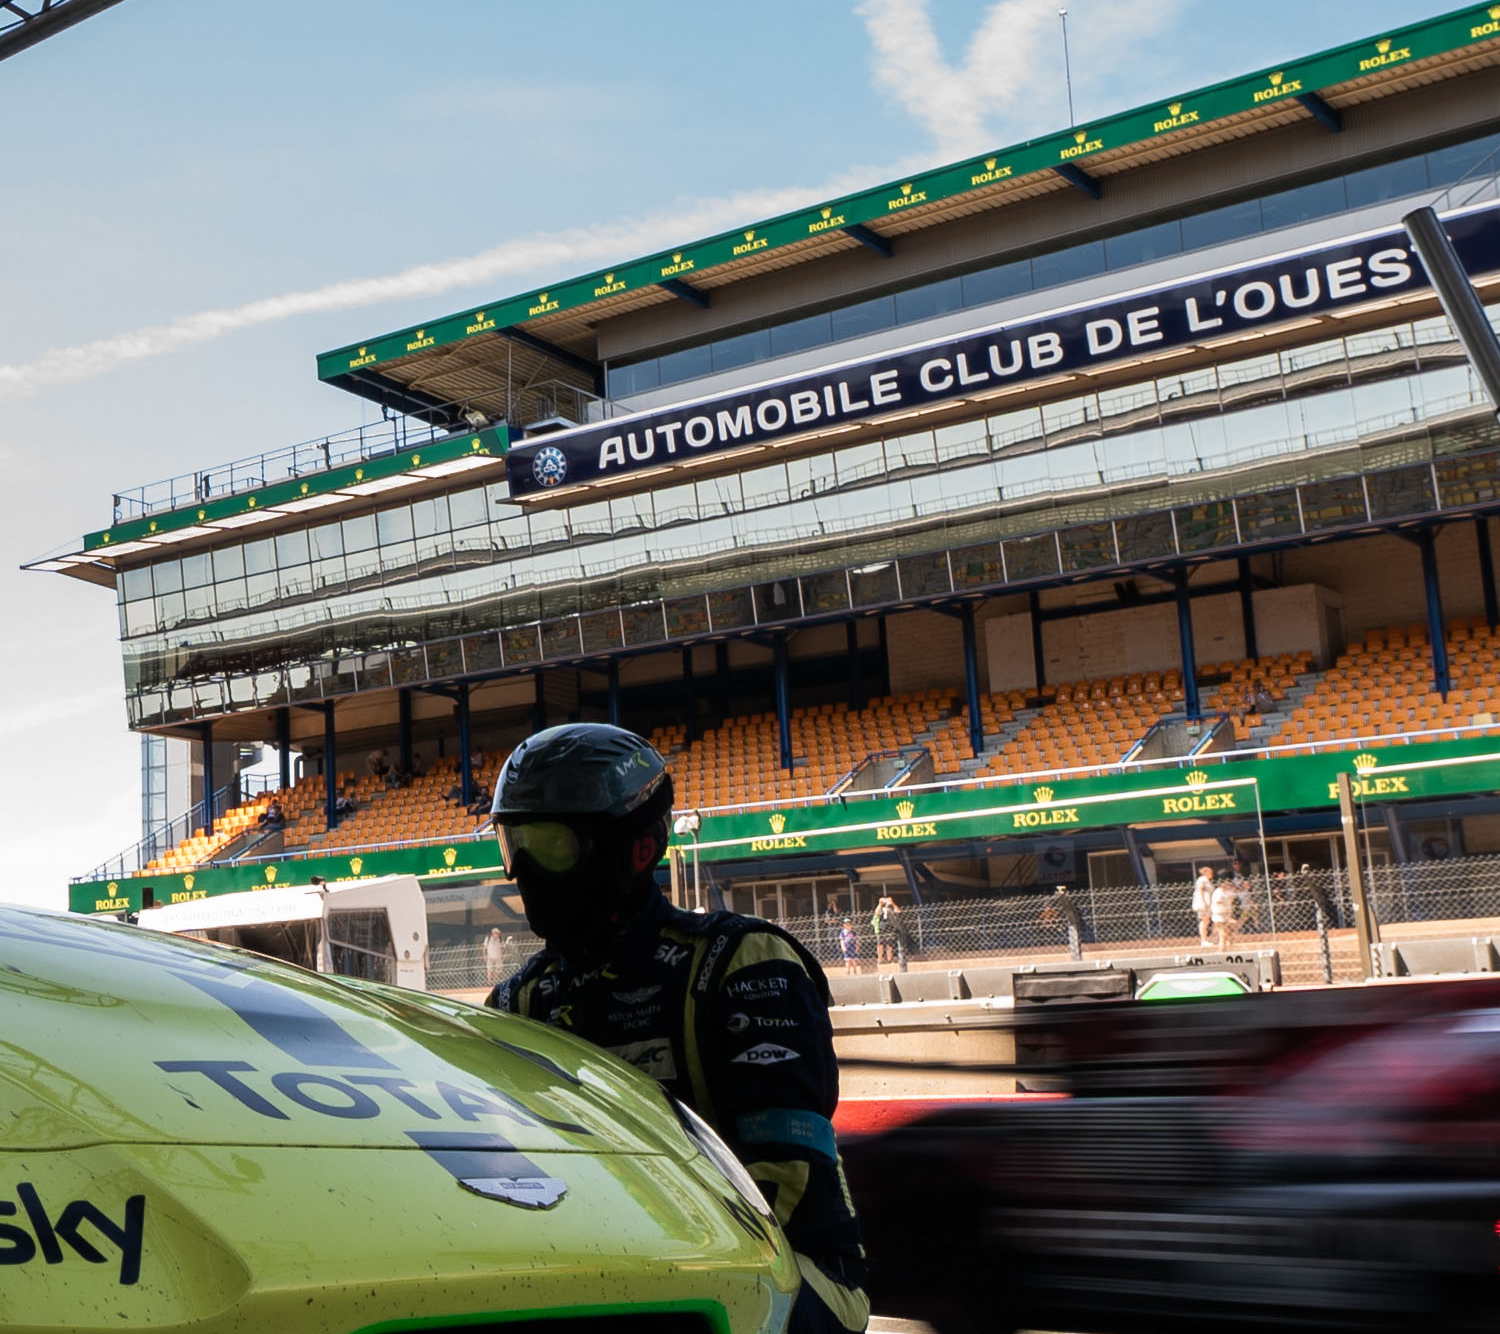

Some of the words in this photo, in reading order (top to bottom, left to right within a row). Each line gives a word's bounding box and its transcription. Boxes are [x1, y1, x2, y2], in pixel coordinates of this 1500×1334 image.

[1358, 47, 1411, 71] ROLEX
[1253, 79, 1302, 102] ROLEX
[1153, 110, 1199, 132] ROLEX
[1060, 139, 1103, 160] ROLEX
[971, 166, 1012, 185] ROLEX
[888, 191, 927, 210] ROLEX
[808, 215, 845, 233] ROLEX
[733, 238, 768, 255] ROLEX
[661, 260, 694, 277] ROLEX
[594, 281, 626, 297] ROLEX
[529, 300, 559, 316] ROLEX
[466, 319, 495, 335] ROLEX
[407, 336, 435, 351] ROLEX
[599, 368, 903, 469] AUTOMOBILE
[919, 331, 1064, 394] CLUB
[1086, 307, 1163, 354] DE
[1185, 233, 1453, 332] L'OUES
[350, 354, 377, 367] ROLEX
[1162, 793, 1236, 814] ROLEX
[1013, 808, 1080, 828] ROLEX
[876, 822, 938, 840] ROLEX
[751, 835, 807, 852] ROLEX
[95, 897, 130, 911] ROLEX
[171, 890, 208, 905] ROLEX
[726, 977, 790, 998] HACKETT
[754, 1016, 800, 1028] TOTAL
[746, 1047, 789, 1061] DOW
[155, 1059, 590, 1135] TOTAL
